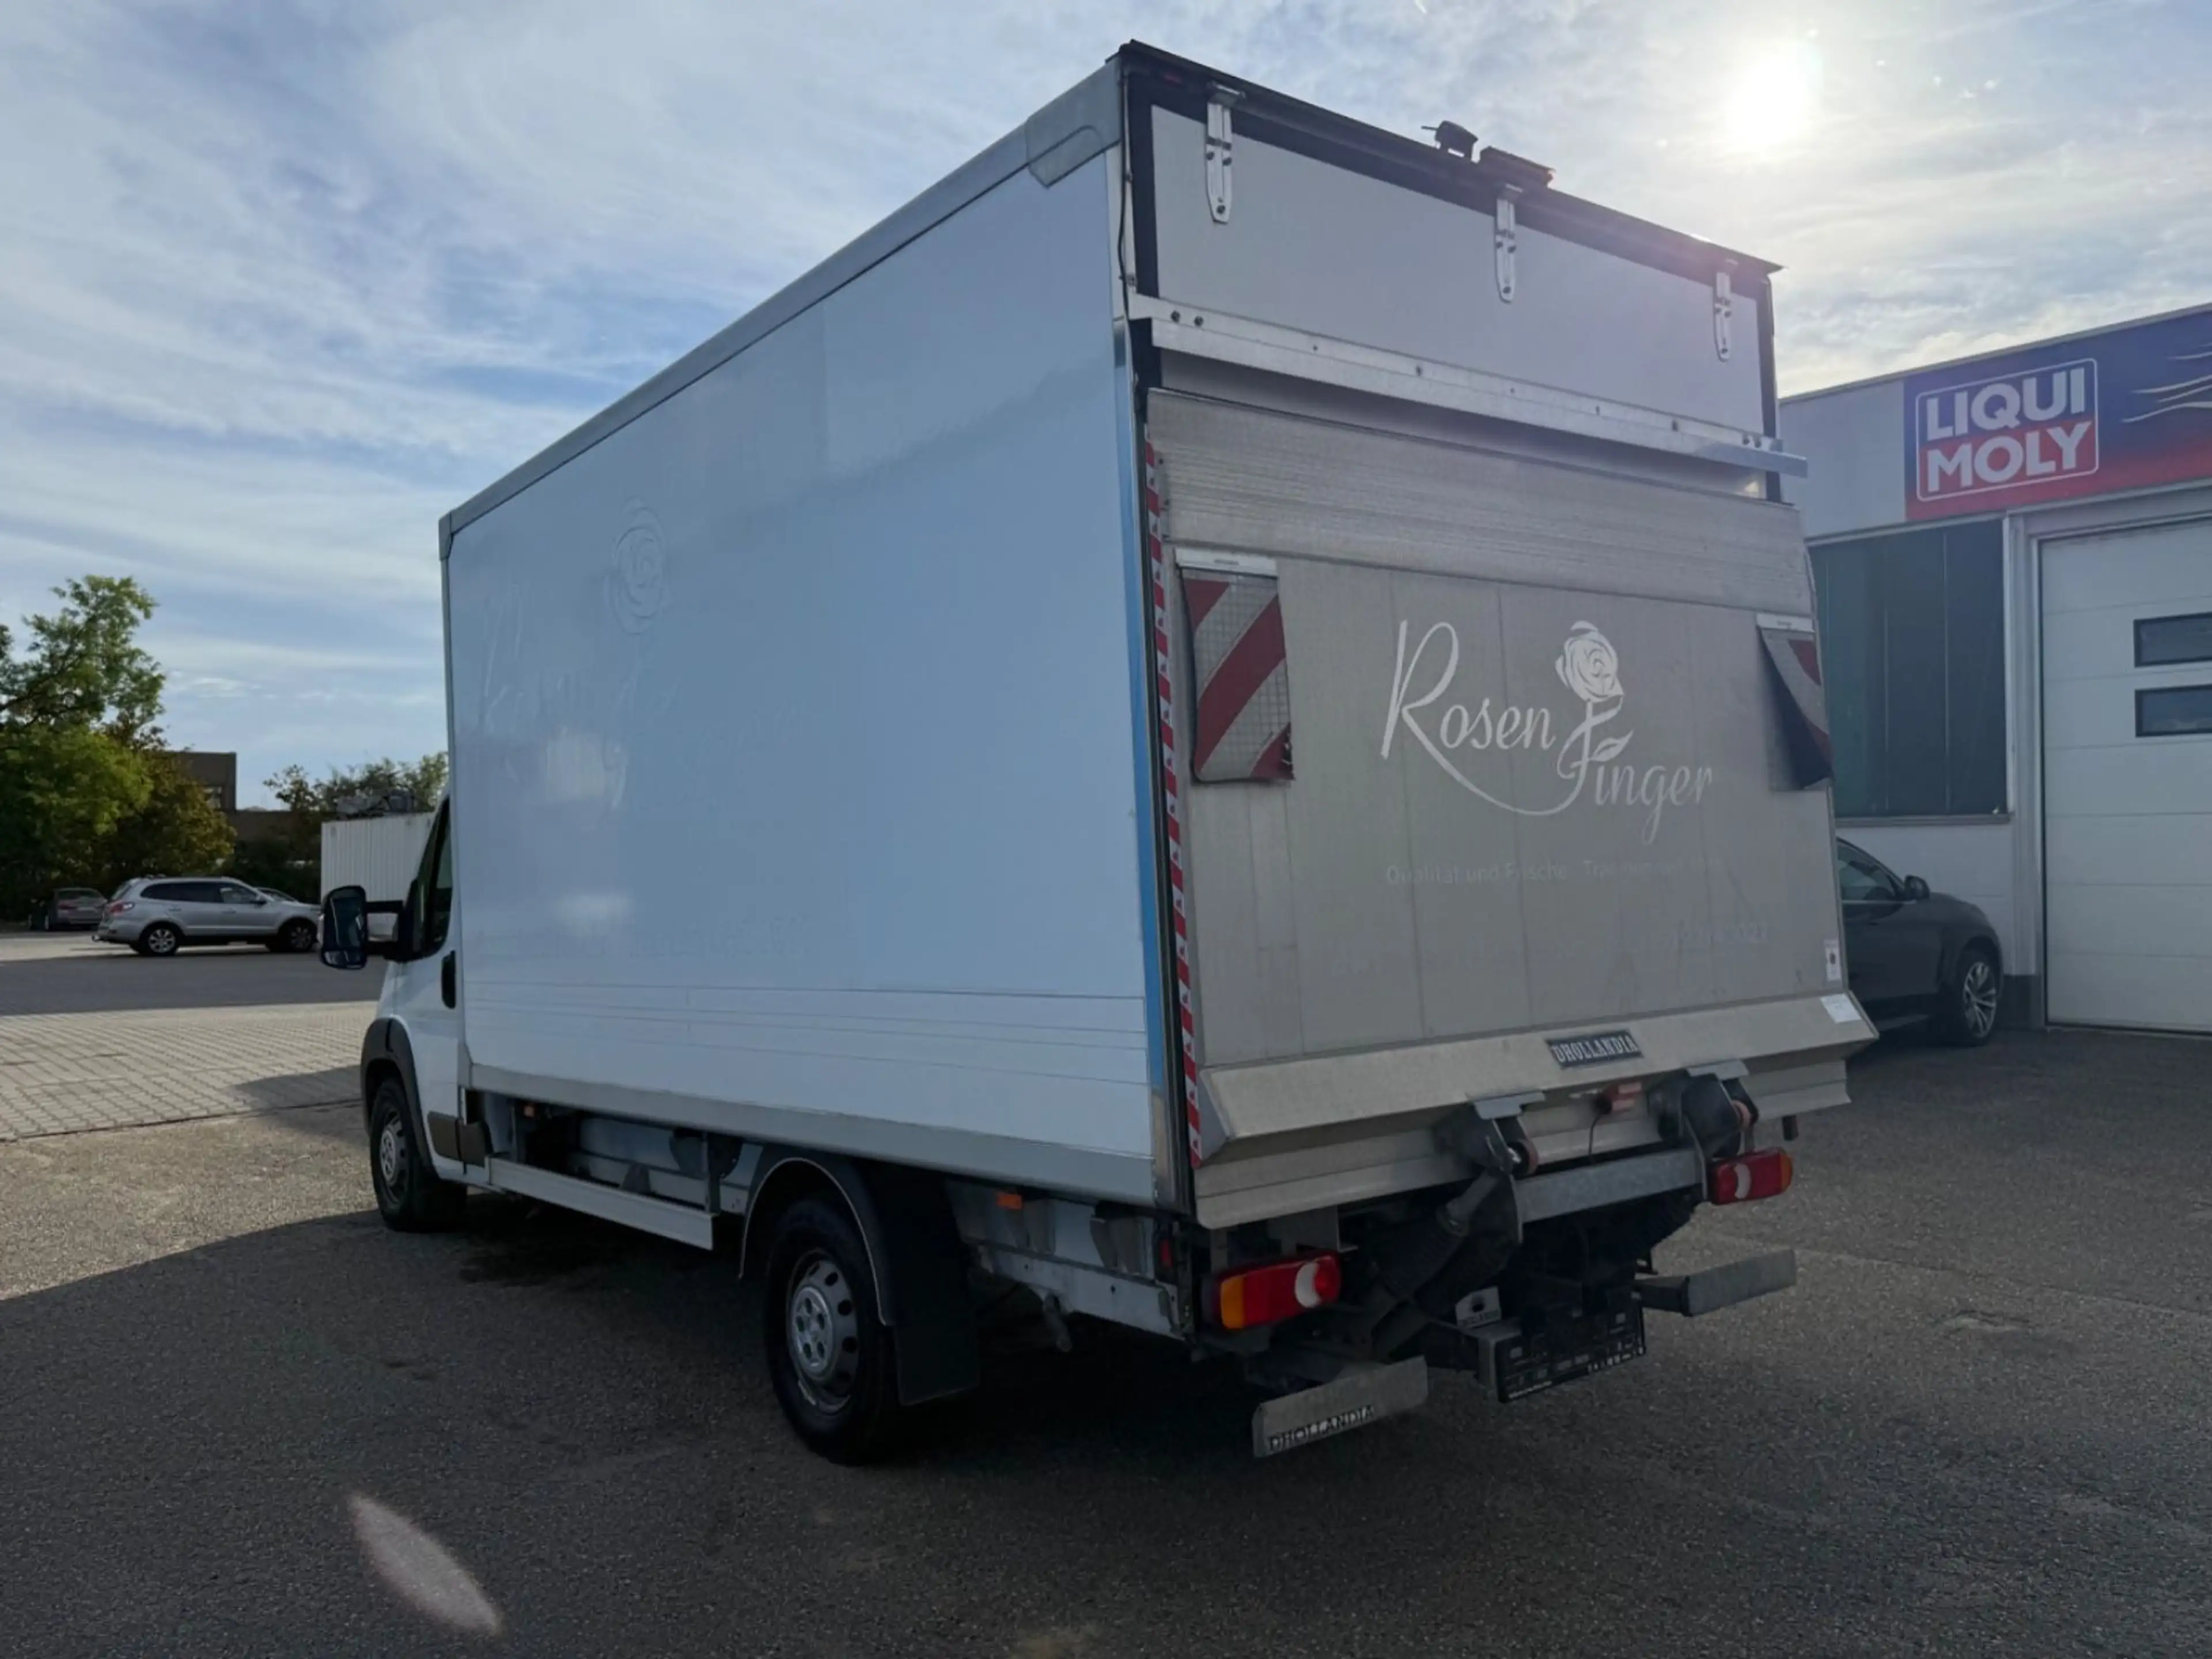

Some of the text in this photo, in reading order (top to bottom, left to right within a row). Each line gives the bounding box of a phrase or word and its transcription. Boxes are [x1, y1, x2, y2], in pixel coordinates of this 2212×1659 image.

[1926, 368, 2085, 441] LIQUI
[1927, 421, 2092, 493] MOLY
[1380, 619, 1555, 759] Rosen
[1556, 697, 1713, 844] Finger
[1551, 1035, 1639, 1063] DHOLLANDIA
